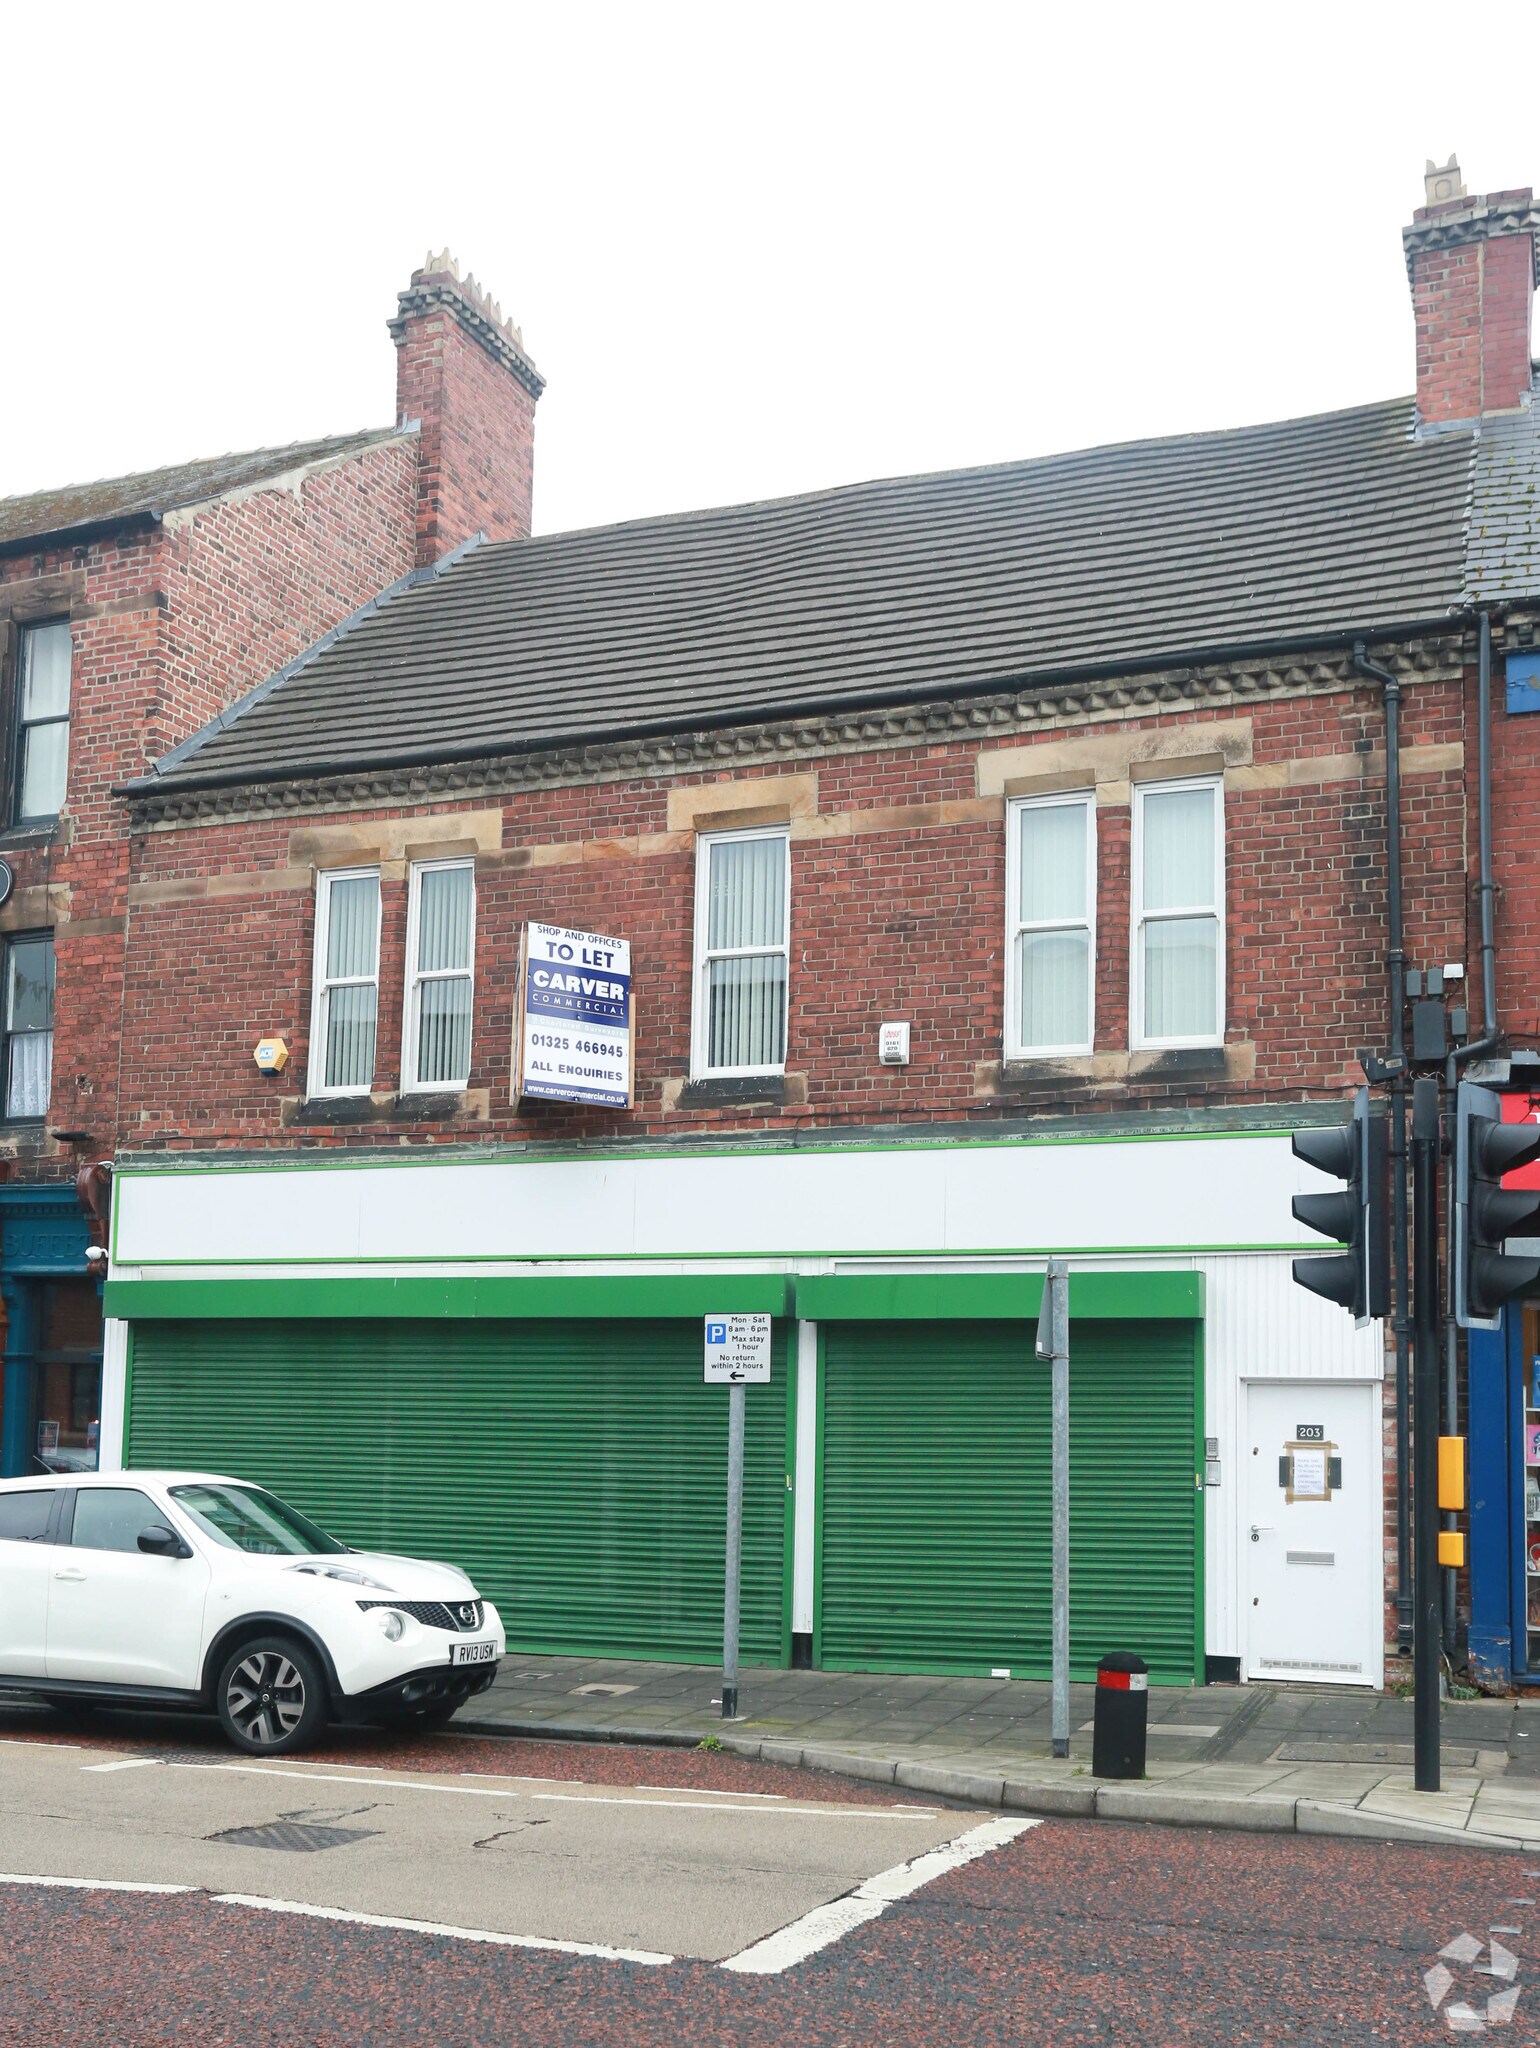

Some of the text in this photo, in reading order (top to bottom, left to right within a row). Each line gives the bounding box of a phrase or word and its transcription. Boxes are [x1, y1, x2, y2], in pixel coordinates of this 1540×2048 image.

[537, 925, 622, 949] SHOP AND OFFICES
[546, 941, 614, 968] TO LET
[533, 970, 624, 1001] CARVER
[532, 993, 624, 1015] COMMERCIAL
[531, 1033, 623, 1058] 01325 466945
[531, 1061, 623, 1081] ALL ENQUIRIES
[527, 1084, 626, 1104] www.carvercommercial.co.uk
[711, 1325, 724, 1342] P
[1299, 1427, 1321, 1437] 203
[460, 1646, 479, 1662] RV13
